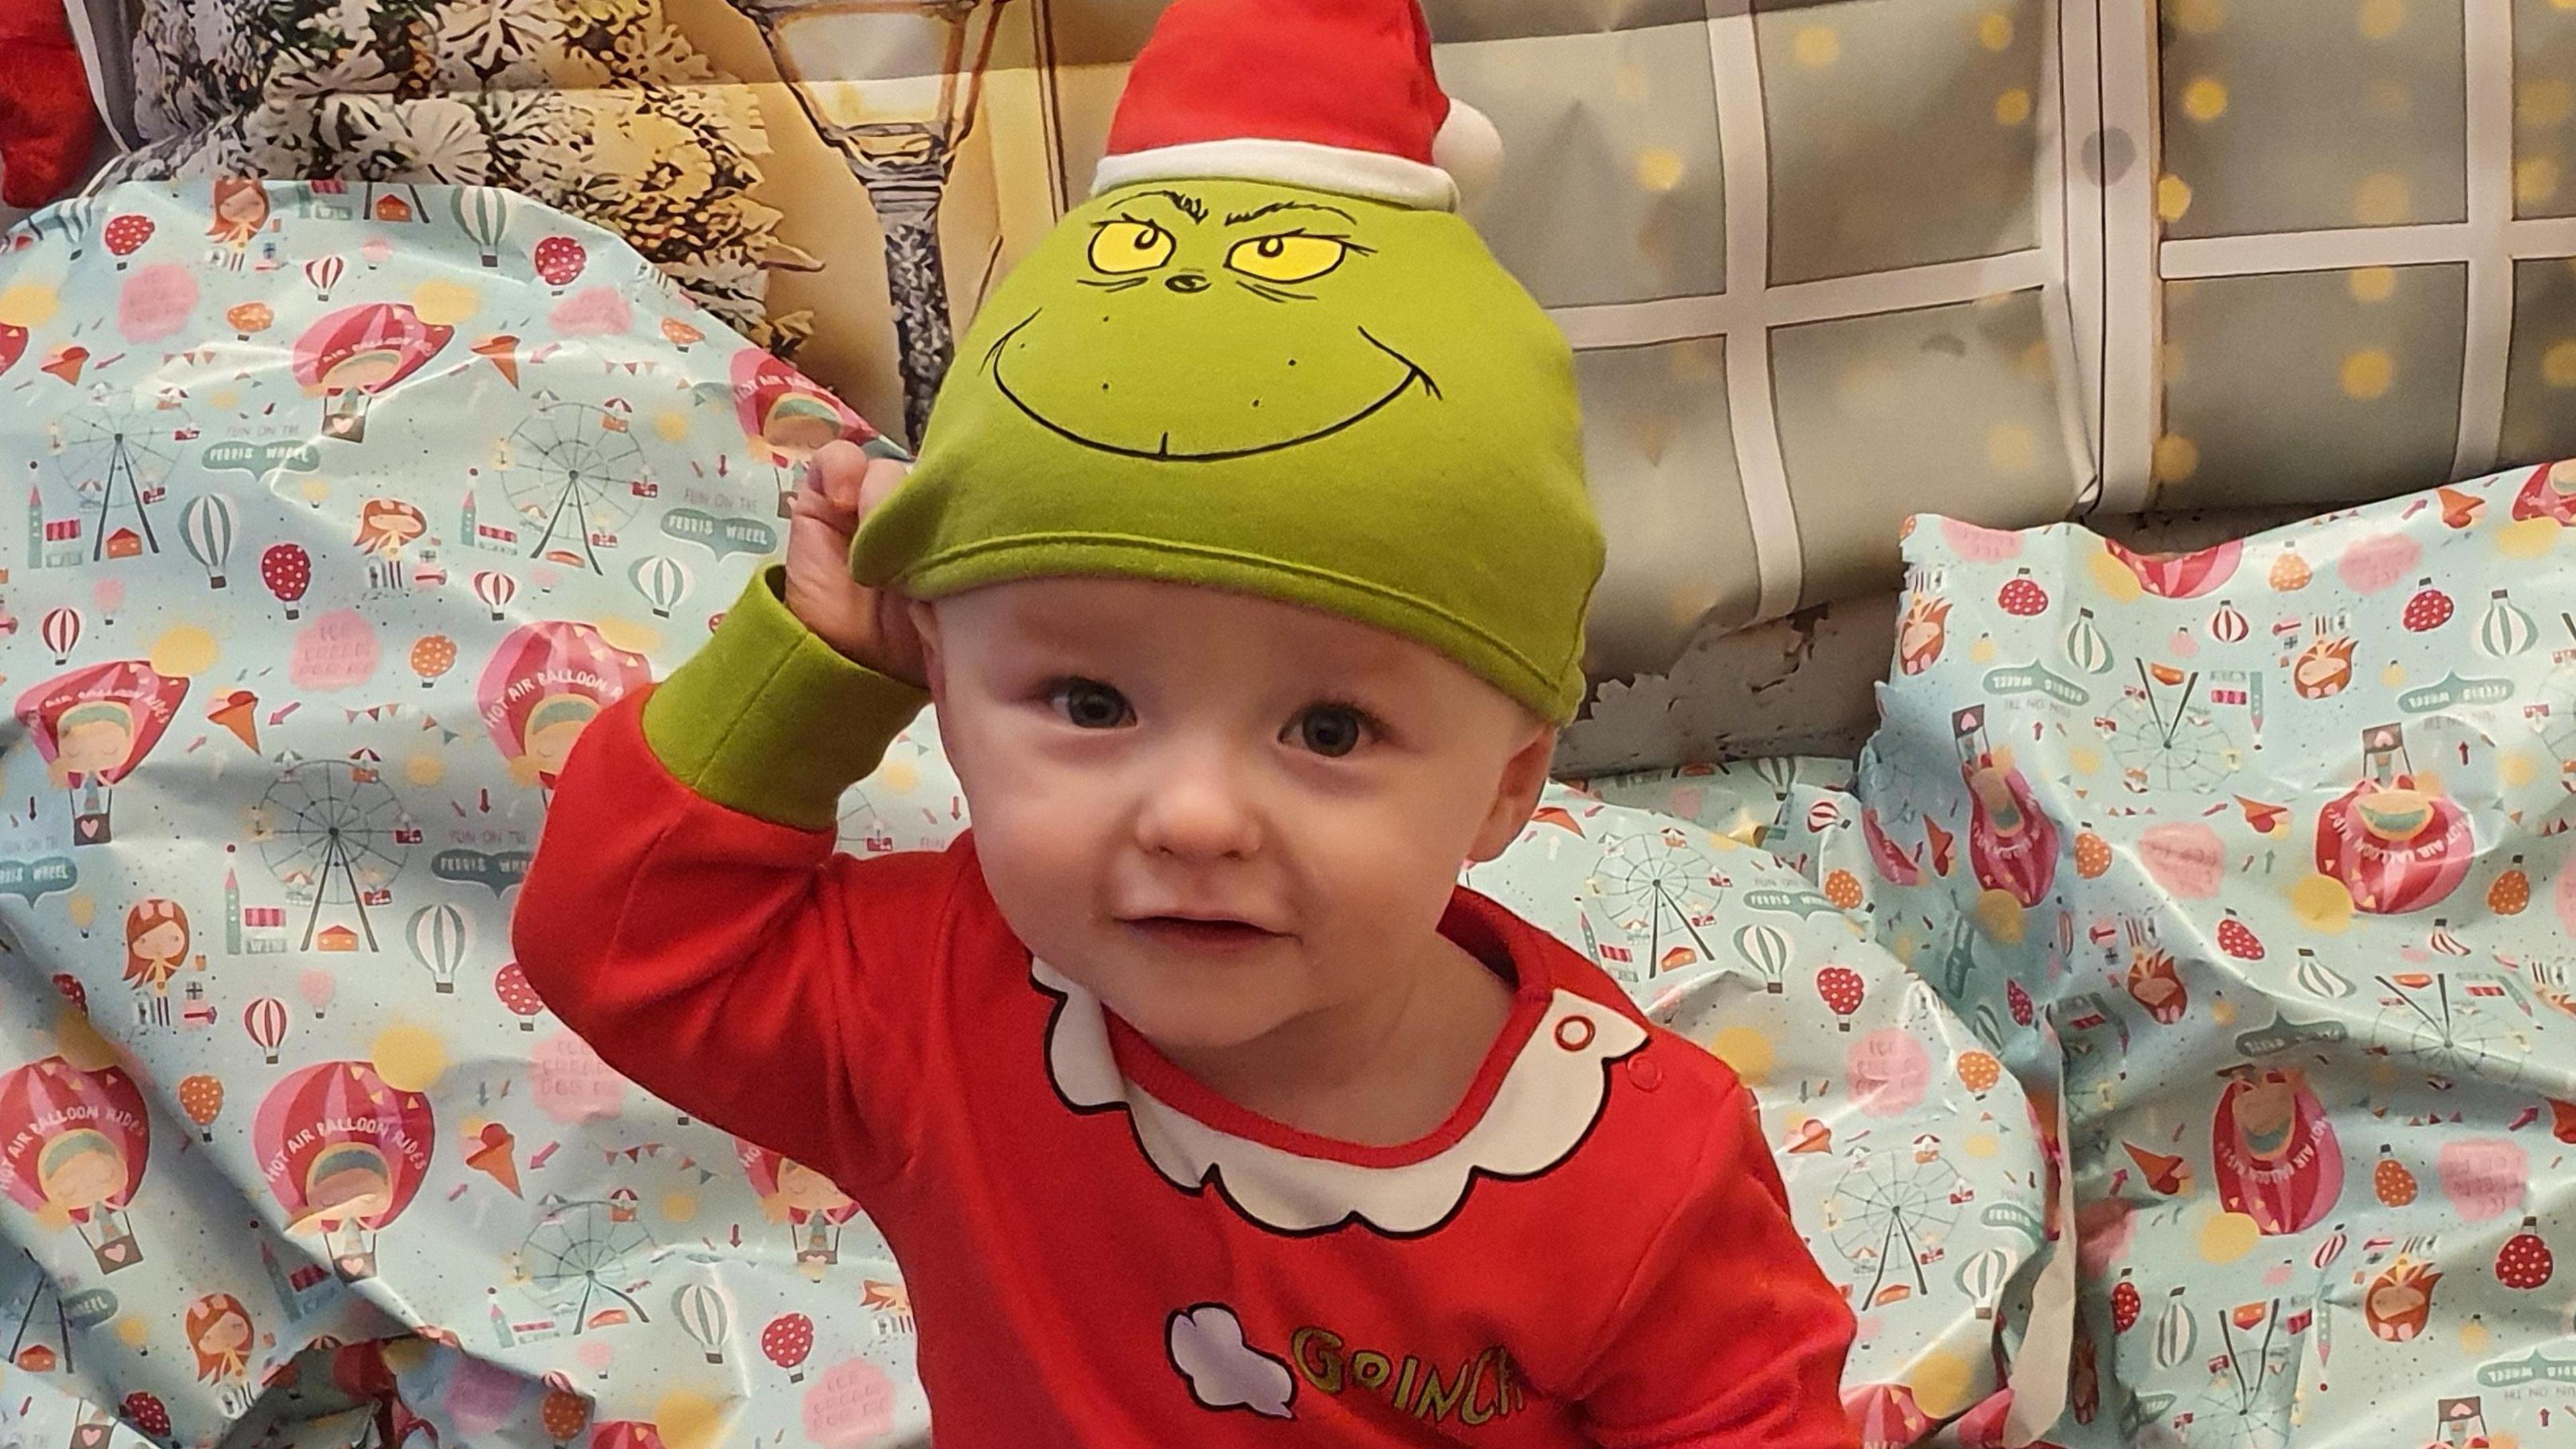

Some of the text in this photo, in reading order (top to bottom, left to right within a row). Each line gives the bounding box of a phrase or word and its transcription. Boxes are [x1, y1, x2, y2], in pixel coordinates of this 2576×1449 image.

[484, 696, 509, 729] HOT
[508, 678, 536, 702] AIR
[537, 669, 608, 692] BALLOON
[2416, 839, 2445, 859] AIR
[7, 1131, 34, 1159] AIR
[28, 1106, 99, 1135] BALLOON
[264, 1116, 427, 1183] HOT AIR BALLOON RIDES
[738, 1147, 762, 1168] HO
[2292, 1142, 2314, 1169] AIR
